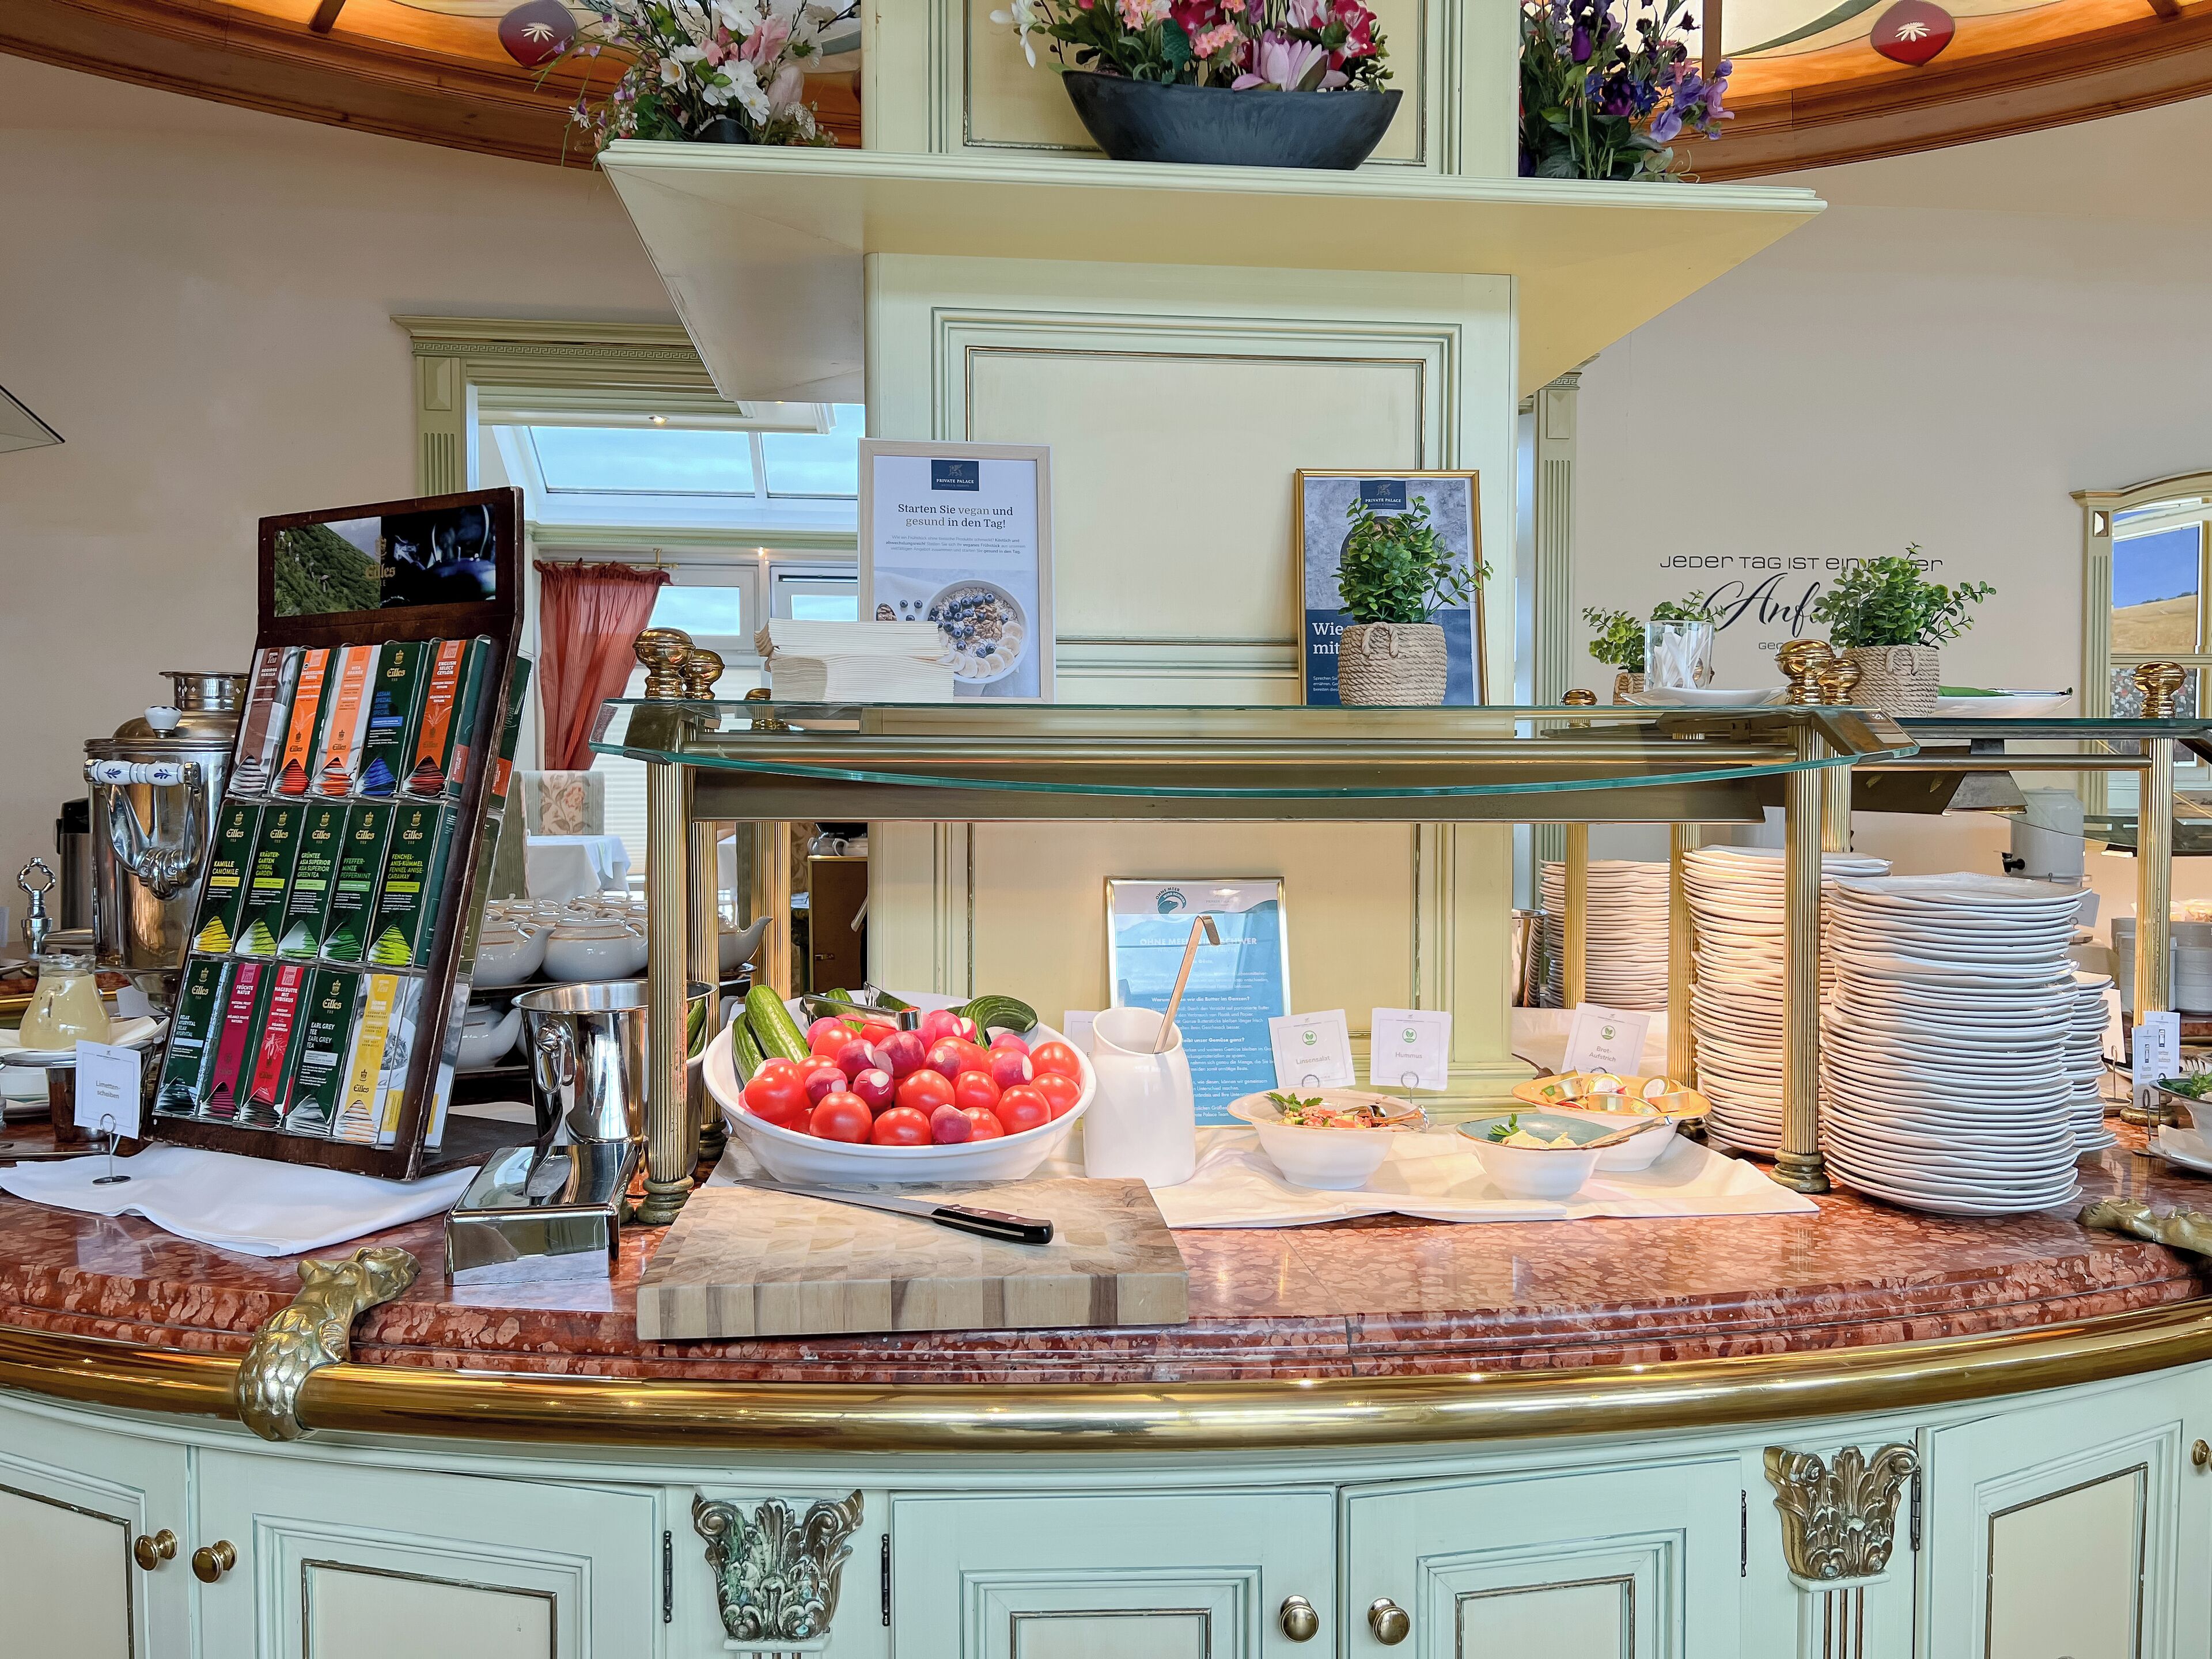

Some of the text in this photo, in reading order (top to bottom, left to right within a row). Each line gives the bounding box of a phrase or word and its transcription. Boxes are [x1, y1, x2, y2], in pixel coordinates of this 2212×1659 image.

[898, 504, 1013, 516] Starten Sie vegan und
[906, 517, 1006, 529] gesund in den Tag!
[1313, 641, 1340, 654] mit
[387, 668, 406, 677] Eilles
[226, 828, 244, 838] Eilles
[270, 829, 289, 839] Eilles
[312, 830, 331, 840] Eilles
[356, 830, 375, 840] Eilles
[403, 830, 423, 840] Eilles
[1156, 888, 1166, 899] OHNE
[192, 986, 209, 995] Eilles
[323, 998, 342, 1009] Eilles
[1296, 1055, 1331, 1065] Linsensalat
[1589, 1052, 1616, 1062] Aufstrich
[354, 1084, 369, 1093] Eilles
